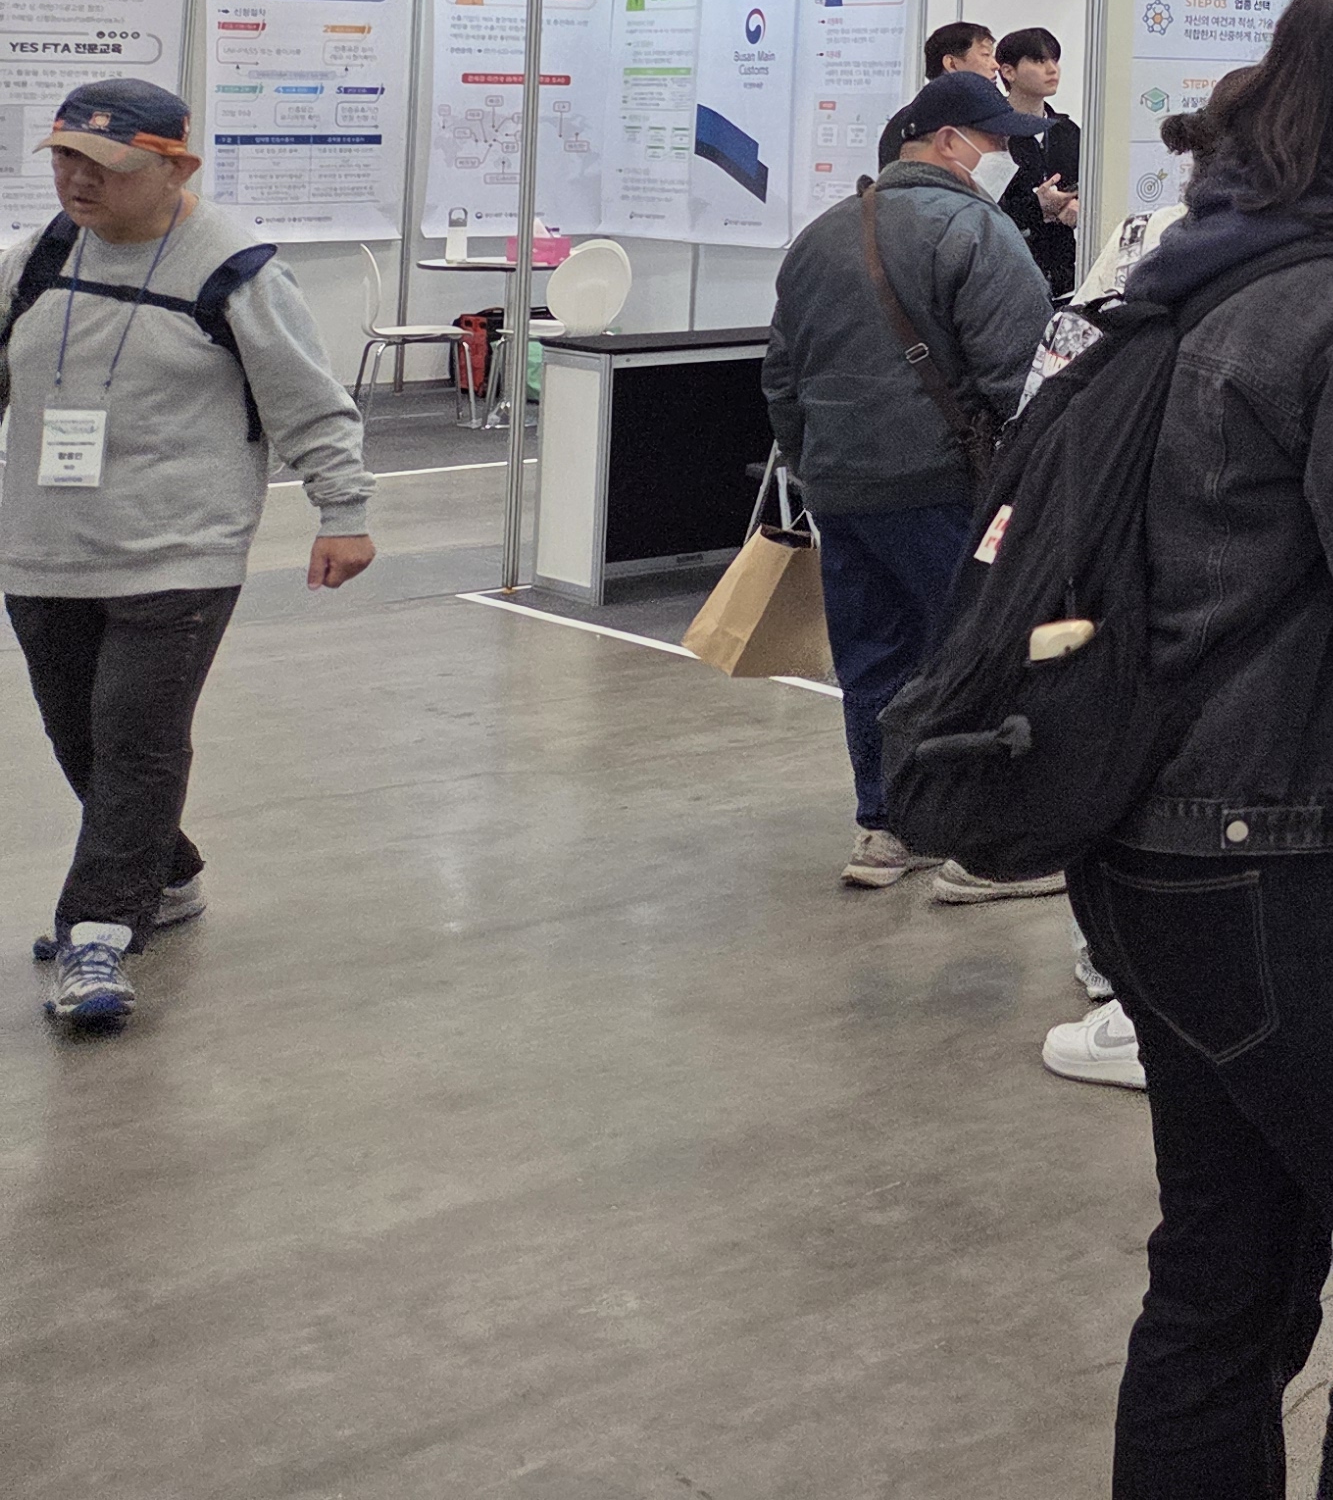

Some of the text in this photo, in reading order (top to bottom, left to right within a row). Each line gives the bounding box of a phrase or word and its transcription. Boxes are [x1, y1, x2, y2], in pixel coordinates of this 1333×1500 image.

[9, 42, 39, 53] YES
[42, 42, 71, 53] FTA
[739, 65, 769, 75] Customs
[1183, 79, 1209, 89] STEP
